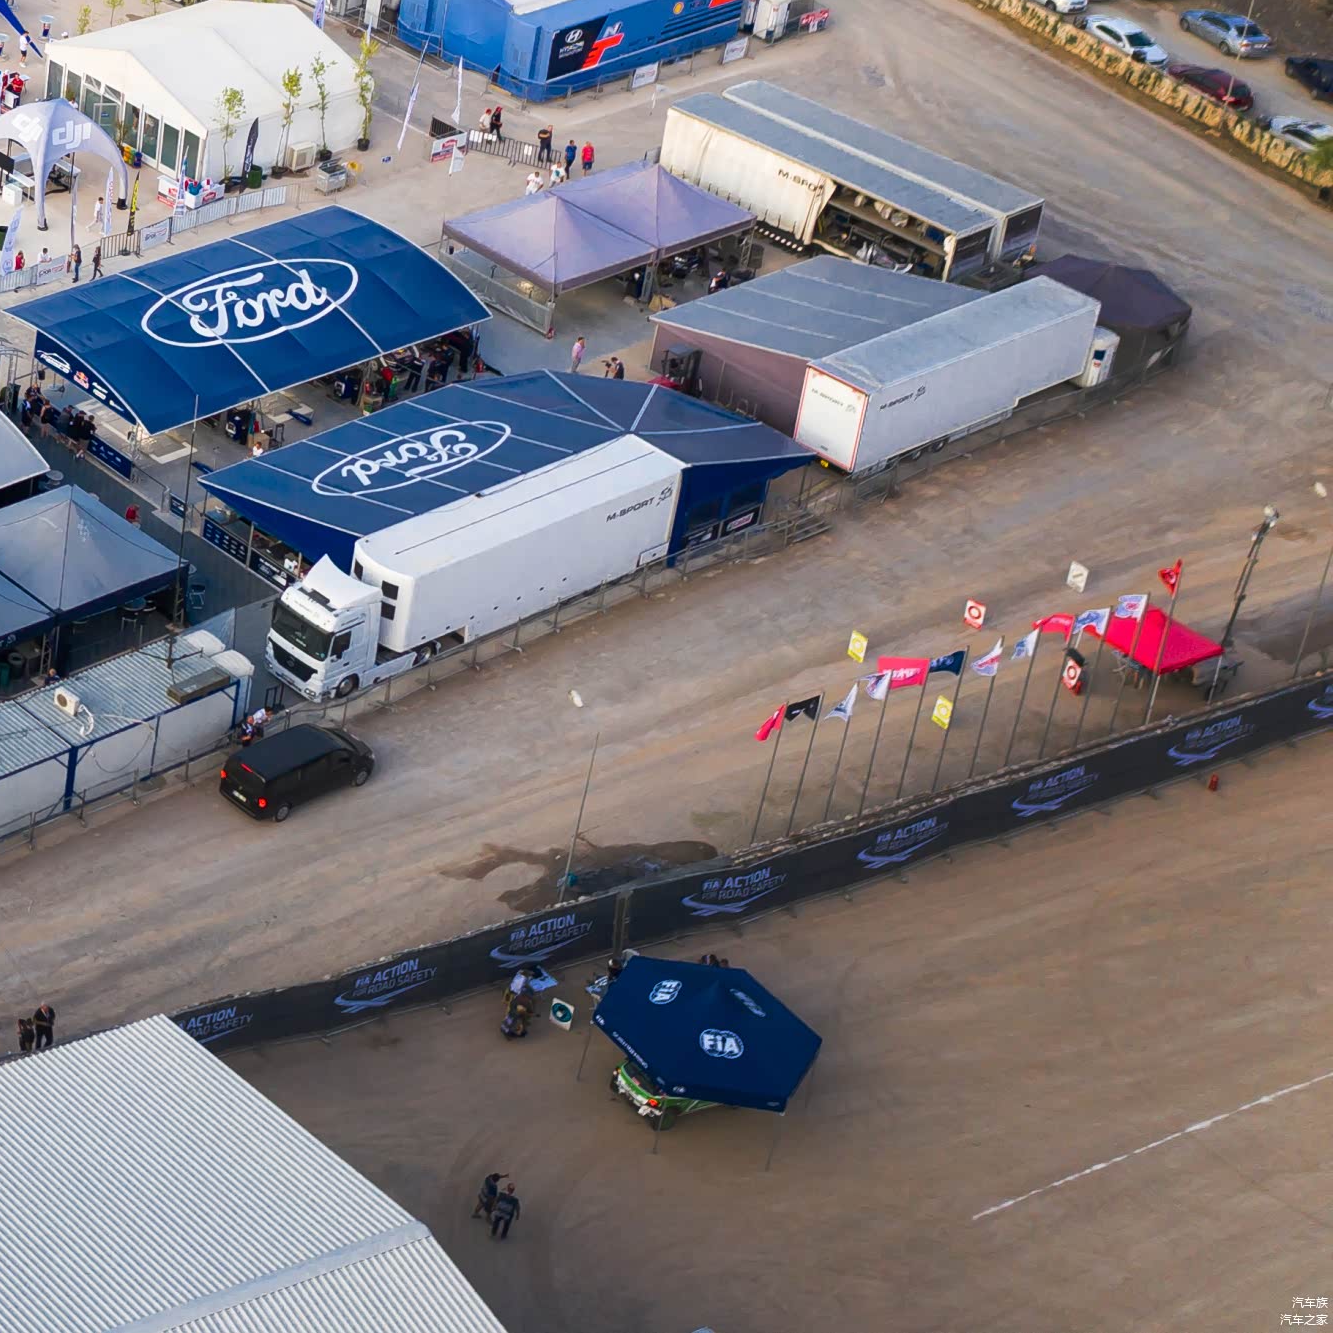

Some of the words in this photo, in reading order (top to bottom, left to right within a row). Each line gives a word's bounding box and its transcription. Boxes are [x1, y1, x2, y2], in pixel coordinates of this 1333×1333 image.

[52, 119, 92, 150] dji
[181, 268, 328, 338] Ford
[340, 428, 479, 486] Ford
[606, 496, 655, 523] M-SPORT
[1044, 764, 1085, 785] ACTION
[893, 816, 938, 841] ACTION
[723, 867, 772, 890] ACTION
[717, 885, 749, 901] ROAD
[523, 931, 553, 951] ROAD
[553, 919, 594, 942] SAFETY
[527, 912, 576, 938] ACTION
[368, 977, 397, 996] ROAD
[397, 966, 438, 989] SAFETY
[373, 958, 420, 983] ACTION
[186, 1005, 238, 1031] ACTION
[212, 1013, 254, 1035] SAFETY
